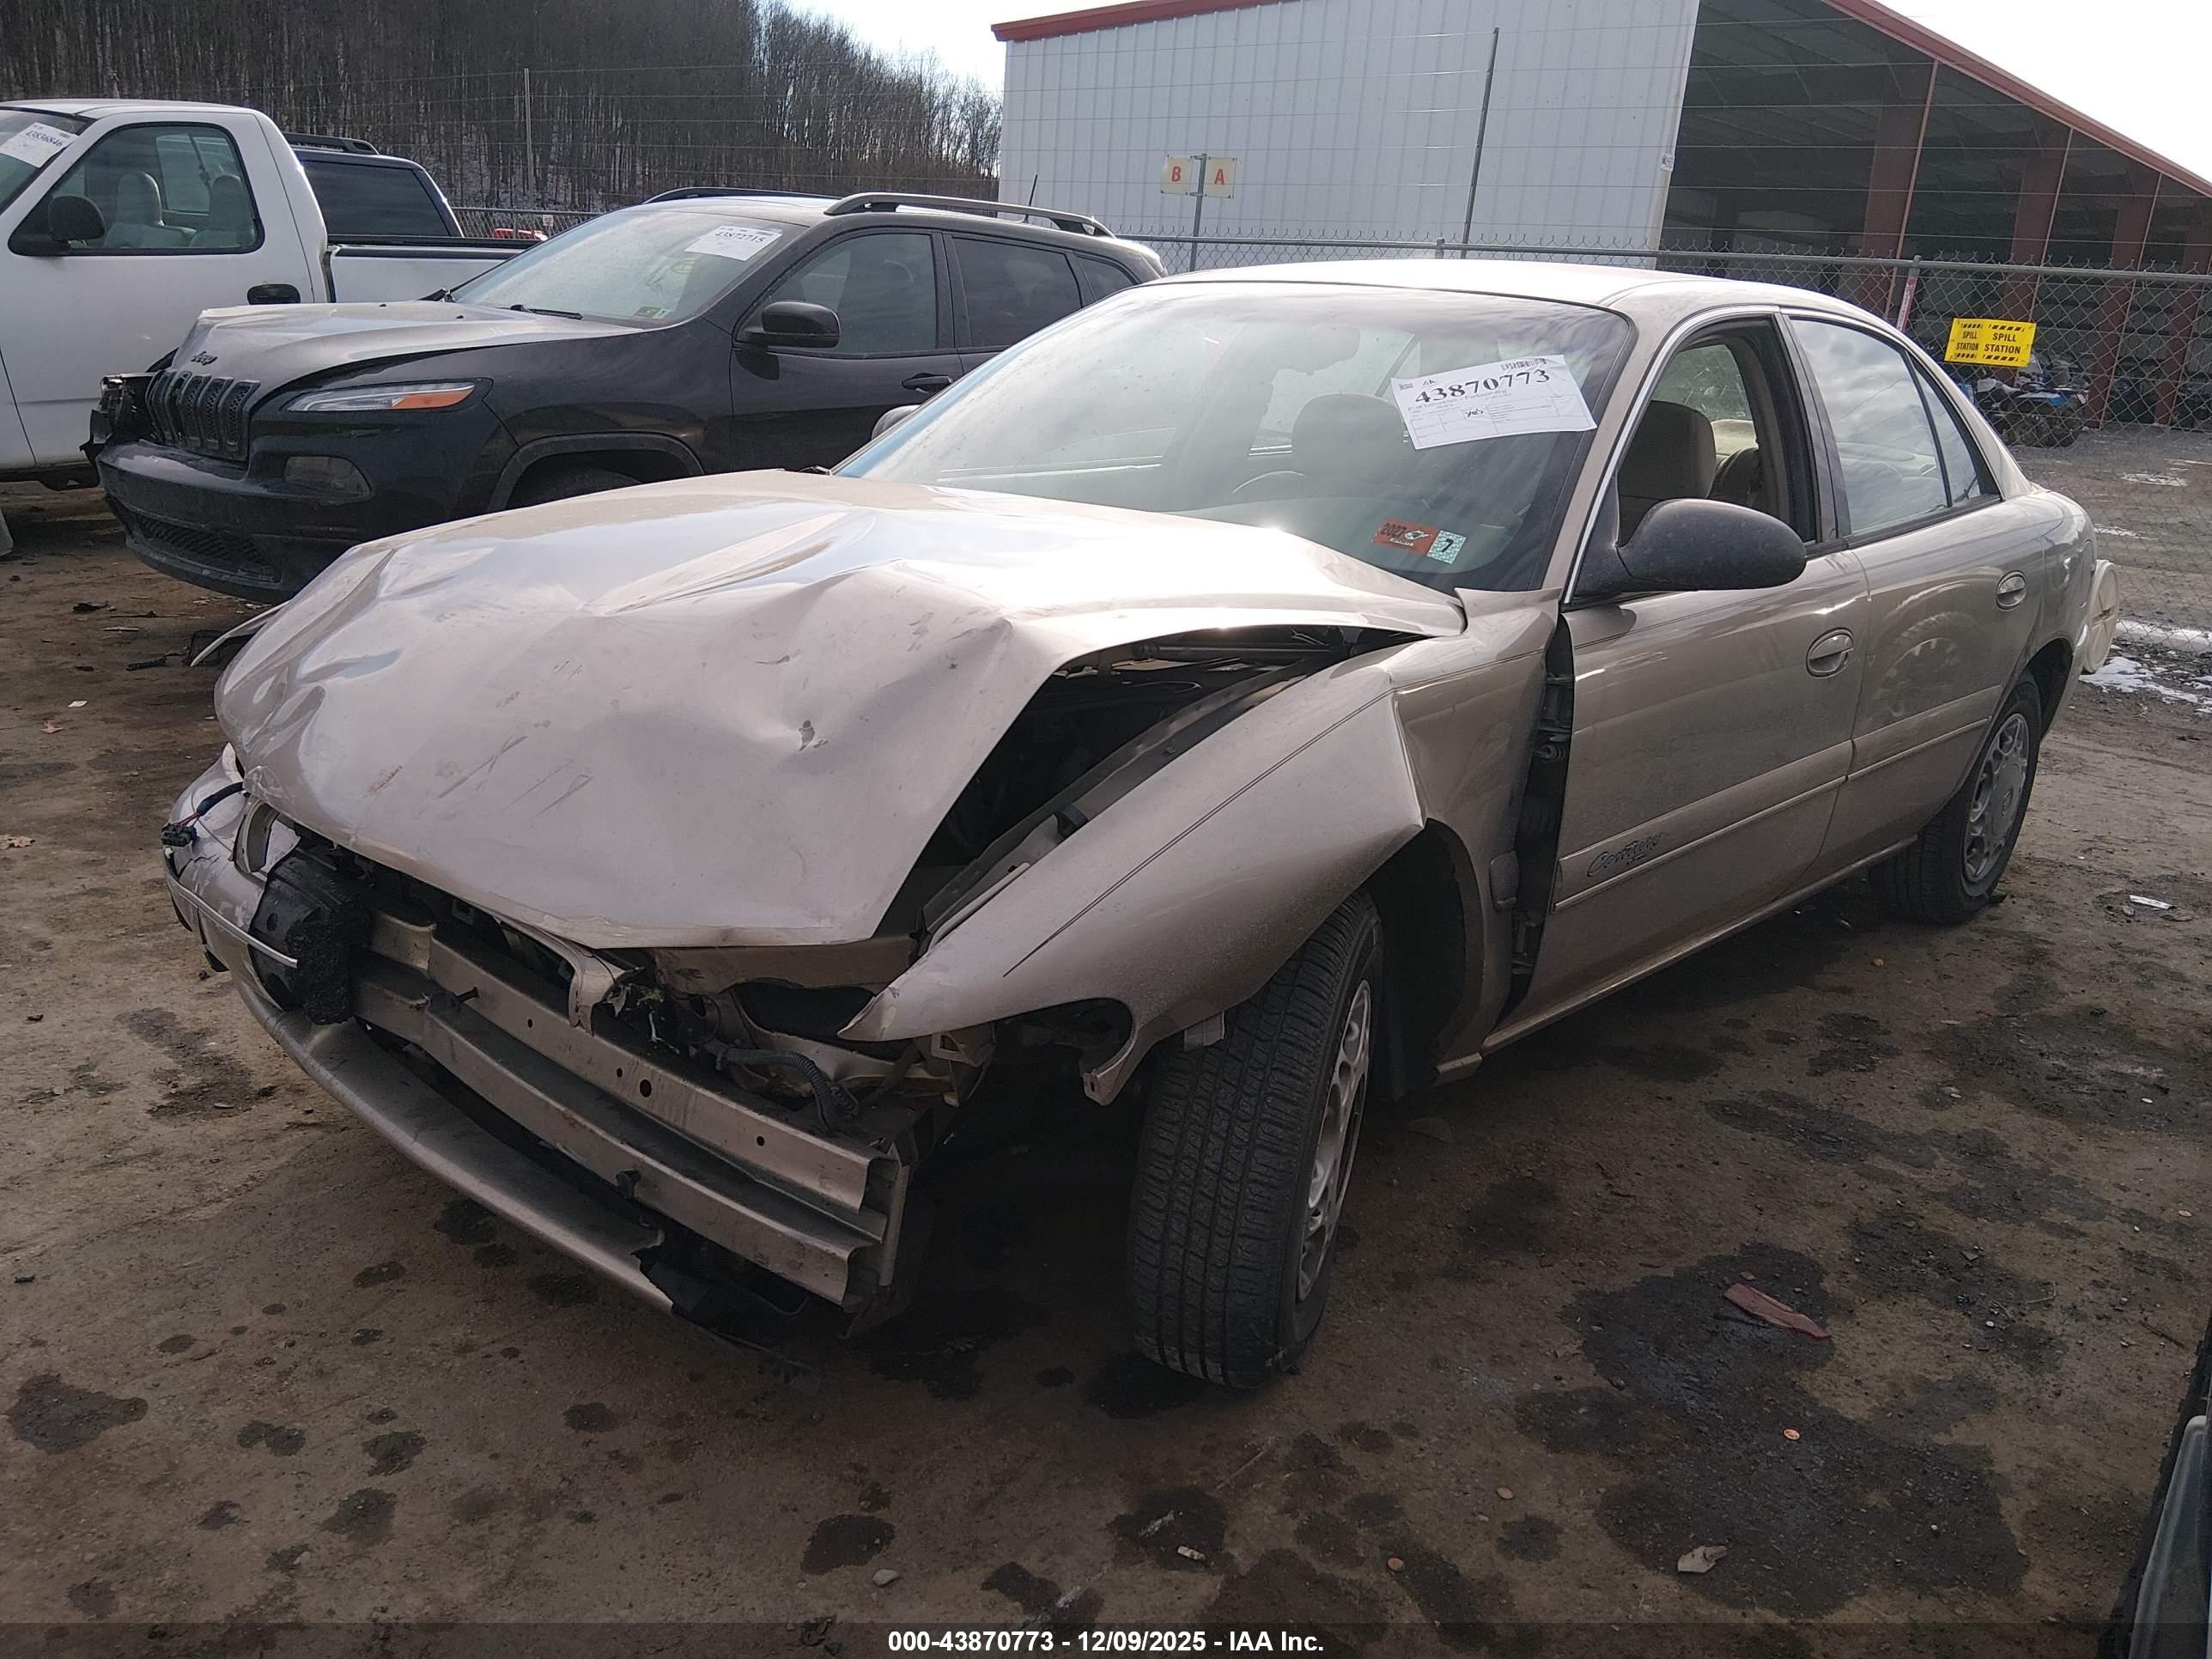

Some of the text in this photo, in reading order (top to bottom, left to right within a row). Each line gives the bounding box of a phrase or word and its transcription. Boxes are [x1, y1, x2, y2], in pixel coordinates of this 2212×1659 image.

[1171, 166, 1182, 182] B
[1213, 168, 1225, 185] A
[1962, 331, 1978, 339] SPILL
[1992, 332, 2017, 343] SPILL
[1956, 342, 1979, 351] STATION
[1984, 343, 2021, 354] STATION
[1414, 368, 1551, 404] 43870773
[1440, 538, 1455, 553] 7
